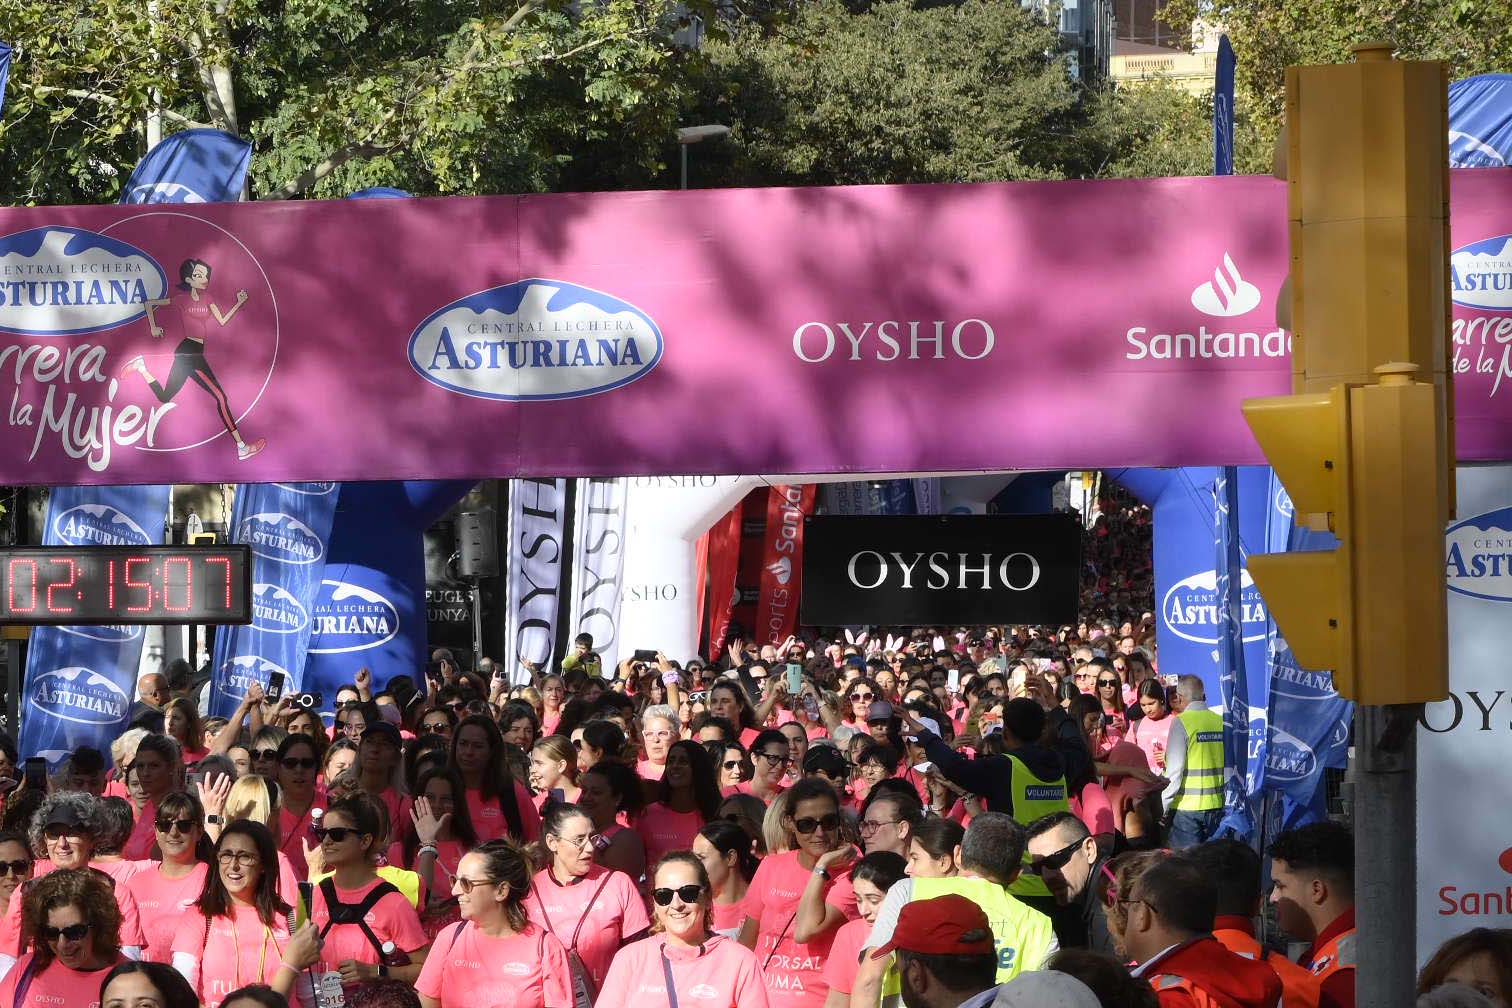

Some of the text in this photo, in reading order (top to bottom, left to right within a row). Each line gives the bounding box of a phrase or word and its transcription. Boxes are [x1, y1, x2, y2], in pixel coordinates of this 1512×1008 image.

[71, 262, 143, 273] LECHERA
[1451, 264, 1512, 291] ASTU
[1468, 261, 1512, 269] CENTRA
[467, 319, 635, 335] CENTRAL LECHERA
[792, 319, 995, 363] OYSHO
[1126, 327, 1292, 360] Santand
[1452, 317, 1512, 345] arre
[428, 327, 643, 372] ASTURIANA
[1476, 346, 1494, 373] la
[8, 388, 33, 426] la
[28, 378, 177, 472] Mujer
[776, 485, 803, 553] Santa
[240, 524, 315, 559] ASTURIANA
[1474, 539, 1512, 549] CENT
[516, 478, 559, 670] OYSH
[579, 478, 620, 653] OYSH
[848, 550, 1041, 591] OYSHO
[1446, 542, 1512, 578] ASTU
[9, 557, 230, 612] 02:15:07
[253, 605, 299, 627] URIANA
[312, 616, 389, 634] URIANA
[1272, 664, 1335, 693] URIANA
[36, 681, 122, 717] ASTURIANA
[1419, 691, 1512, 733] OY
[766, 974, 804, 990] UMA
